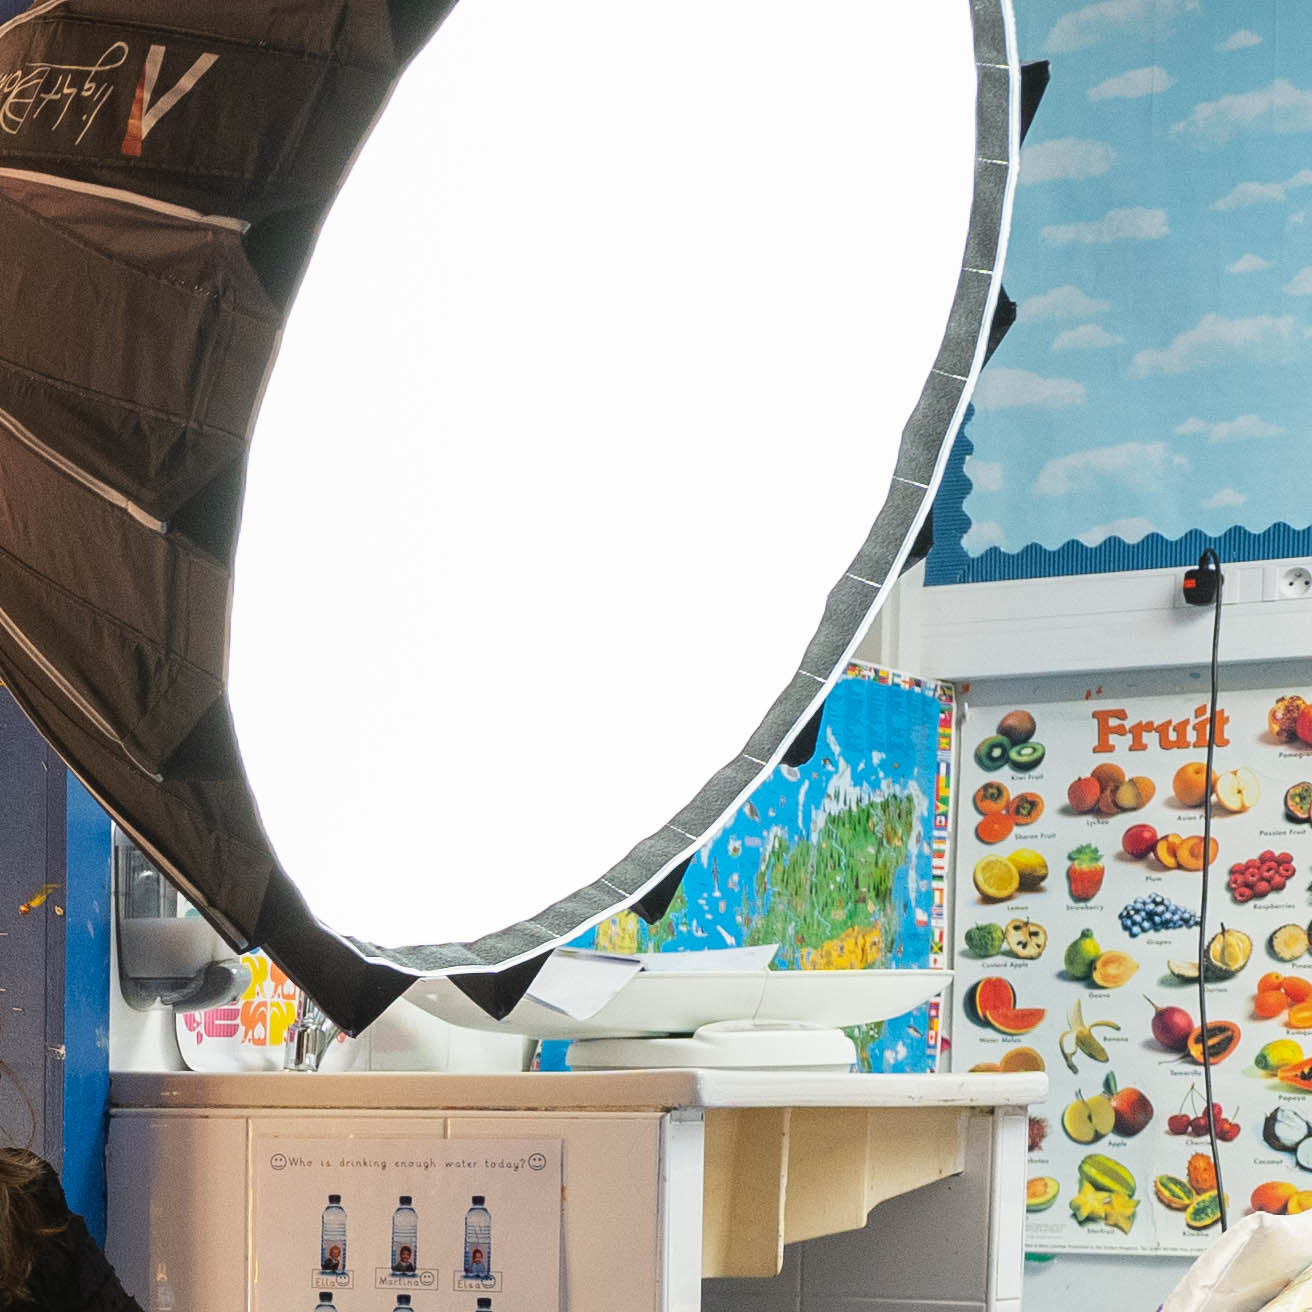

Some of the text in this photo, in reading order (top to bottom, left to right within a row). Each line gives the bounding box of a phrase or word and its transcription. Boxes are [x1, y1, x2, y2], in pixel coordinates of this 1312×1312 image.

[1092, 704, 1230, 754] Fruit
[288, 1157, 526, 1172] Who is drinking enough water today?
